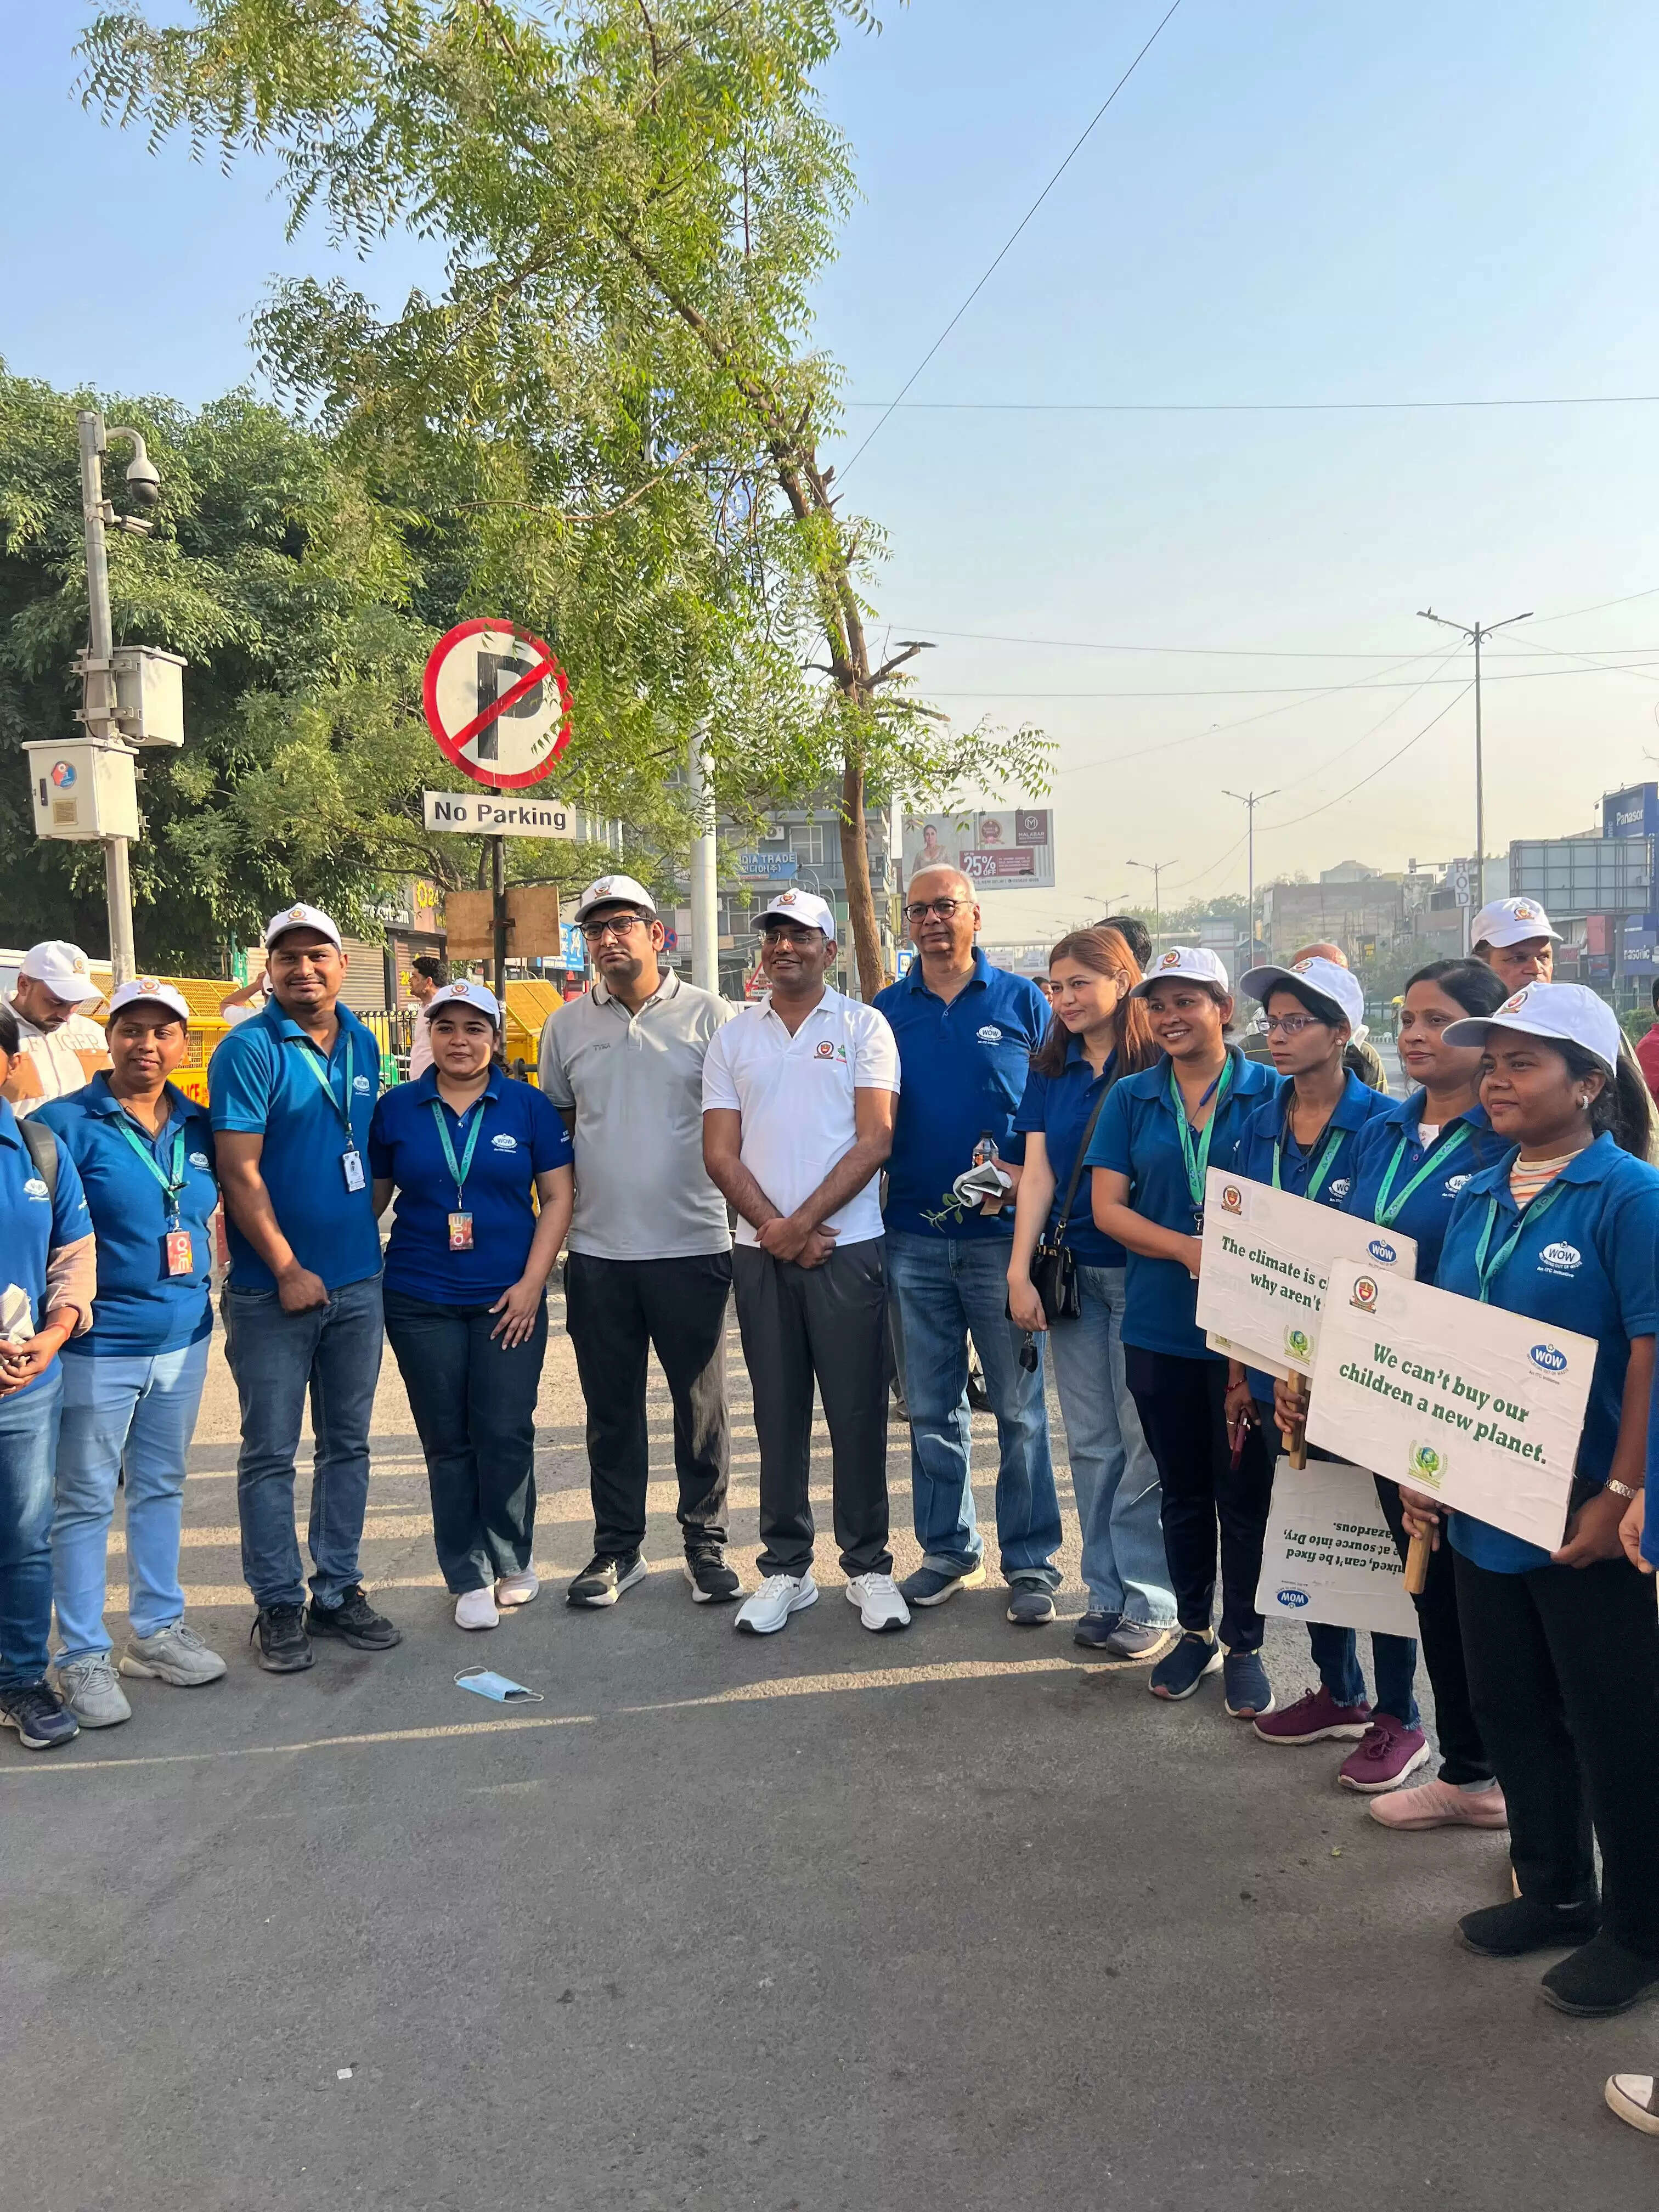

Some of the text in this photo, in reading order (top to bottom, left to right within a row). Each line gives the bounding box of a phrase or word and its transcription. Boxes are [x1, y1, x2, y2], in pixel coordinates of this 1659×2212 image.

[435, 802, 566, 830] No Parking
[761, 854, 795, 864] TRADE
[964, 856, 996, 876] 25%
[1337, 1183, 1350, 1193] WO
[1372, 1244, 1393, 1260] WOW
[1549, 1248, 1576, 1262] WOW
[1222, 1235, 1329, 1290] The climate is c
[1553, 1269, 1575, 1278] Initiative
[1251, 1273, 1278, 1295] why
[1280, 1285, 1321, 1311] aren't
[1536, 1348, 1563, 1368] WOW
[1374, 1342, 1530, 1423] We can't buy our
[1339, 1363, 1547, 1465] children a new planet.
[1283, 1529, 1307, 1545] Dry,
[1309, 1536, 1334, 1549] into
[1335, 1539, 1376, 1553] source
[1378, 1547, 1391, 1555] at
[1286, 1548, 1317, 1563] fixed
[1319, 1554, 1333, 1565] be
[1335, 1557, 1367, 1567] can't
[1280, 1592, 1305, 1604] WOW
